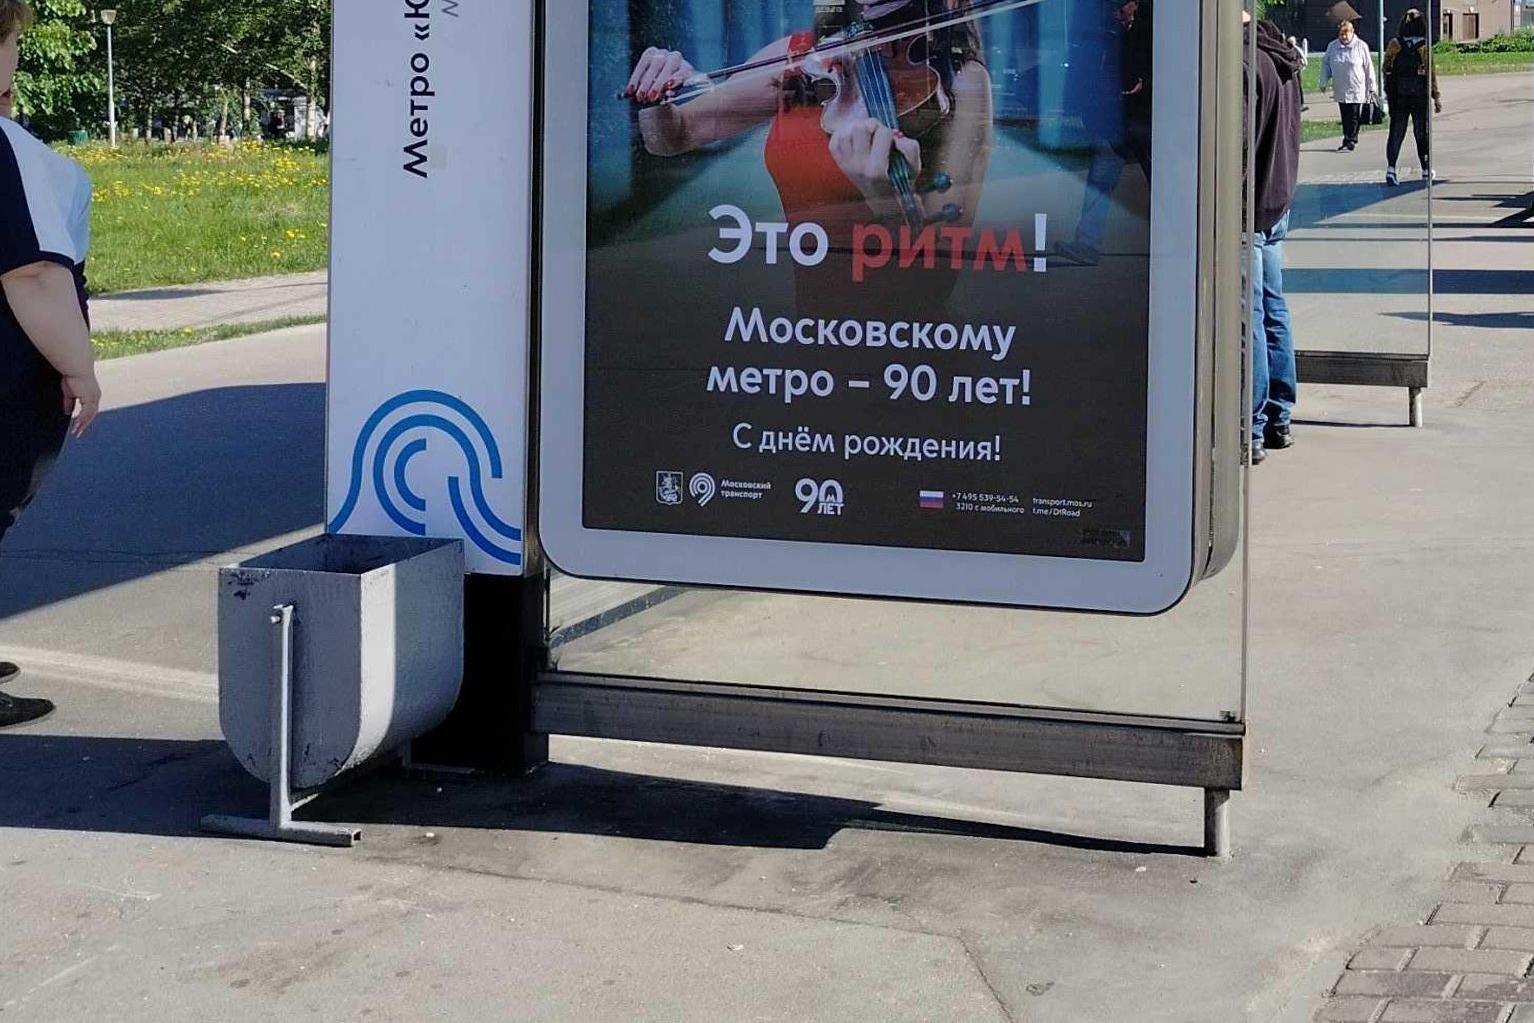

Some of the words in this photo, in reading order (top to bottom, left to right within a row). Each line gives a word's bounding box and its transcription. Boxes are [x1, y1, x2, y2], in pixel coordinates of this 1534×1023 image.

[402, 52, 434, 179] Метро
[708, 204, 829, 265] Это
[851, 213, 1047, 282] ритм!
[724, 307, 1017, 361] Московскому
[706, 366, 834, 404] метро
[883, 365, 937, 402] 90
[948, 368, 1032, 406] лет!
[732, 423, 752, 450] С
[758, 427, 835, 455] днём
[843, 434, 1002, 463] рождения!
[720, 479, 772, 491] Московский
[720, 490, 763, 500] транспорт
[818, 502, 845, 515] ЛЕТ
